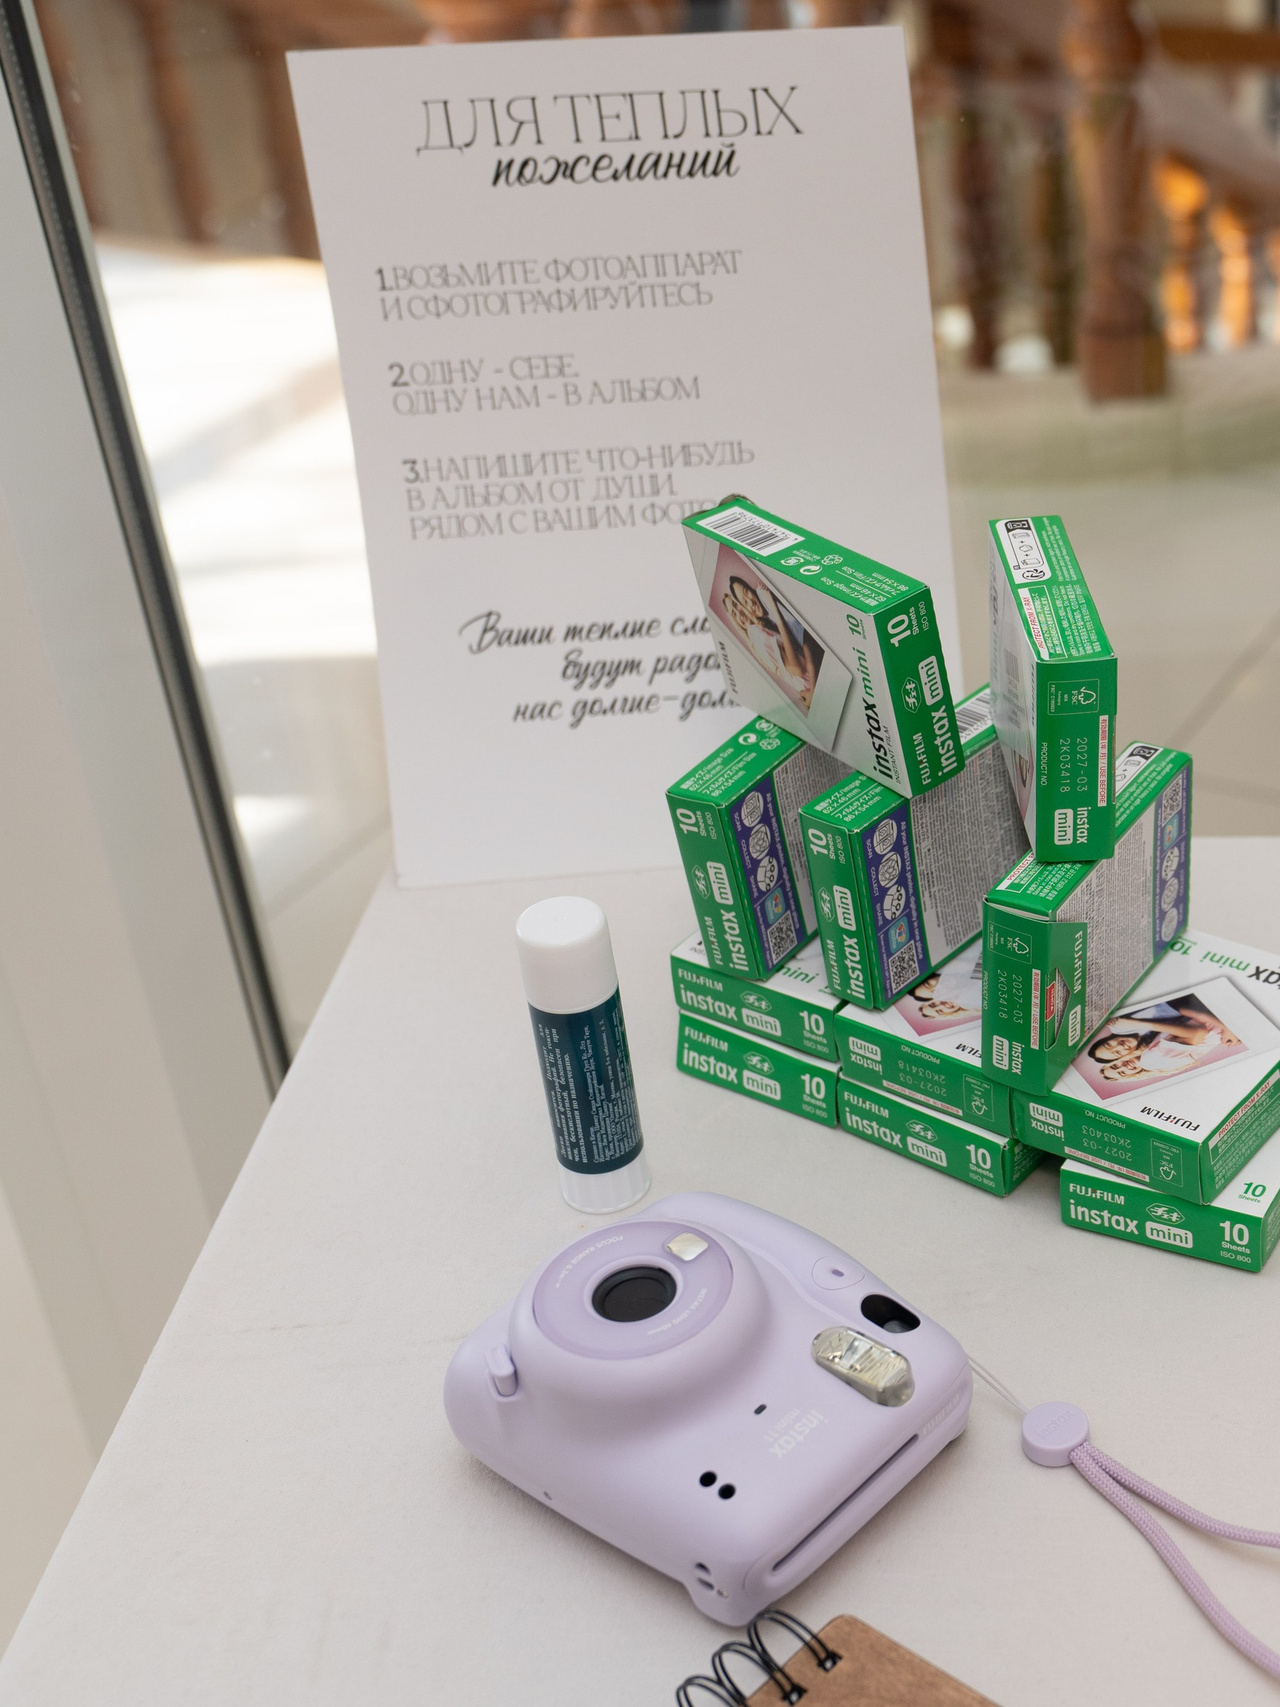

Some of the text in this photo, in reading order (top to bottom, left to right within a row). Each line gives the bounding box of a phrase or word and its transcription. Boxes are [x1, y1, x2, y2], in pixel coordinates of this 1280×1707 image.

[416, 85, 803, 157] ДЛЯ ТЕПЛЫХ
[491, 142, 740, 187] пожеланий
[544, 249, 743, 284] ФОТОАППАРАТ
[380, 280, 714, 322] И СФОТОГРАФИРУЙТЕСЬ
[392, 387, 468, 416] ОДНУ
[475, 383, 541, 412] НАМ
[562, 381, 583, 407] В
[587, 375, 702, 406] АЛЬБОМ
[586, 440, 756, 472] ЧТО-НИБУДЬ
[405, 487, 427, 512] В
[431, 479, 544, 511] АЛЬБОМ
[549, 476, 585, 504] ОТ
[408, 511, 504, 541] РЯДОМ
[508, 509, 529, 535] С
[533, 502, 637, 535] ВАШИМ
[459, 609, 555, 655] Ваши
[846, 614, 862, 637] 10
[887, 606, 920, 648] 10 Sheets
[918, 600, 930, 631] ISO 800
[562, 647, 645, 692] будут
[512, 699, 563, 723] нас
[852, 647, 893, 780] instax mini
[921, 660, 957, 777] instax mini
[882, 725, 902, 785] INSTANT FILM
[912, 732, 932, 786] FUJIFILM
[1040, 742, 1048, 772] PRODUCT
[1059, 737, 1071, 793] 2K03418
[1076, 737, 1088, 792] 2027-03
[1098, 779, 1106, 804] BEFORE
[676, 808, 707, 837] 10 Sheets
[704, 811, 717, 840] ISO 800
[1057, 812, 1071, 842] mini
[1076, 806, 1091, 844] instax
[733, 811, 759, 899] SCAN COLLECT SHARE
[808, 828, 836, 861] 10 Sheets
[835, 835, 846, 865] ISO 800
[870, 866, 880, 897] COLLECT
[875, 903, 884, 927] SHARE
[709, 865, 750, 972] instax mini
[704, 916, 724, 966] FUJIFILM
[836, 889, 866, 1000] instax mini
[827, 939, 842, 990] FUJIFILM
[1074, 930, 1084, 995] FUJIFILM
[1199, 950, 1250, 972] mini
[678, 968, 723, 992] FUJIFILM
[997, 969, 1008, 1019] 2K03418
[679, 984, 778, 1034] instax mini
[1012, 974, 1024, 1024] 2027-03
[684, 1026, 729, 1052] FUJIFILM
[799, 1010, 827, 1045] 10 Sheets
[1070, 1010, 1080, 1043] mini
[850, 1053, 883, 1076] instax
[851, 1038, 879, 1058] mini
[913, 1047, 941, 1064] PRODUCT
[995, 1038, 1008, 1070] mini
[1011, 1041, 1025, 1075] instax
[683, 1043, 778, 1099] instax mini
[898, 1060, 946, 1085] 2K03418
[899, 1073, 948, 1097] 2027-03
[801, 1073, 827, 1109] 10 Sheets
[843, 1091, 889, 1119] FUJIFILM
[1031, 1105, 1061, 1124] mini
[1031, 1118, 1065, 1142] instax
[1095, 1113, 1126, 1129] PRODUCT
[1140, 1105, 1201, 1132] FUJIFILM
[843, 1107, 945, 1165] instax mini
[1082, 1125, 1132, 1149] 2K03403
[1082, 1138, 1133, 1162] 2027-03
[966, 1143, 995, 1179] 10 Sheets
[968, 1171, 983, 1182] ISO
[1069, 1183, 1125, 1205] FUJIFILM
[1237, 1193, 1262, 1205] Sheets
[1243, 1181, 1267, 1198] 10
[1069, 1199, 1190, 1246] instax mini
[1219, 1220, 1250, 1246] 10
[595, 1235, 624, 1249] FOCUS
[1220, 1250, 1252, 1264] ISO 800
[1221, 1242, 1251, 1255] Sheets
[769, 1409, 829, 1458] instax
[775, 1407, 800, 1433] mini
